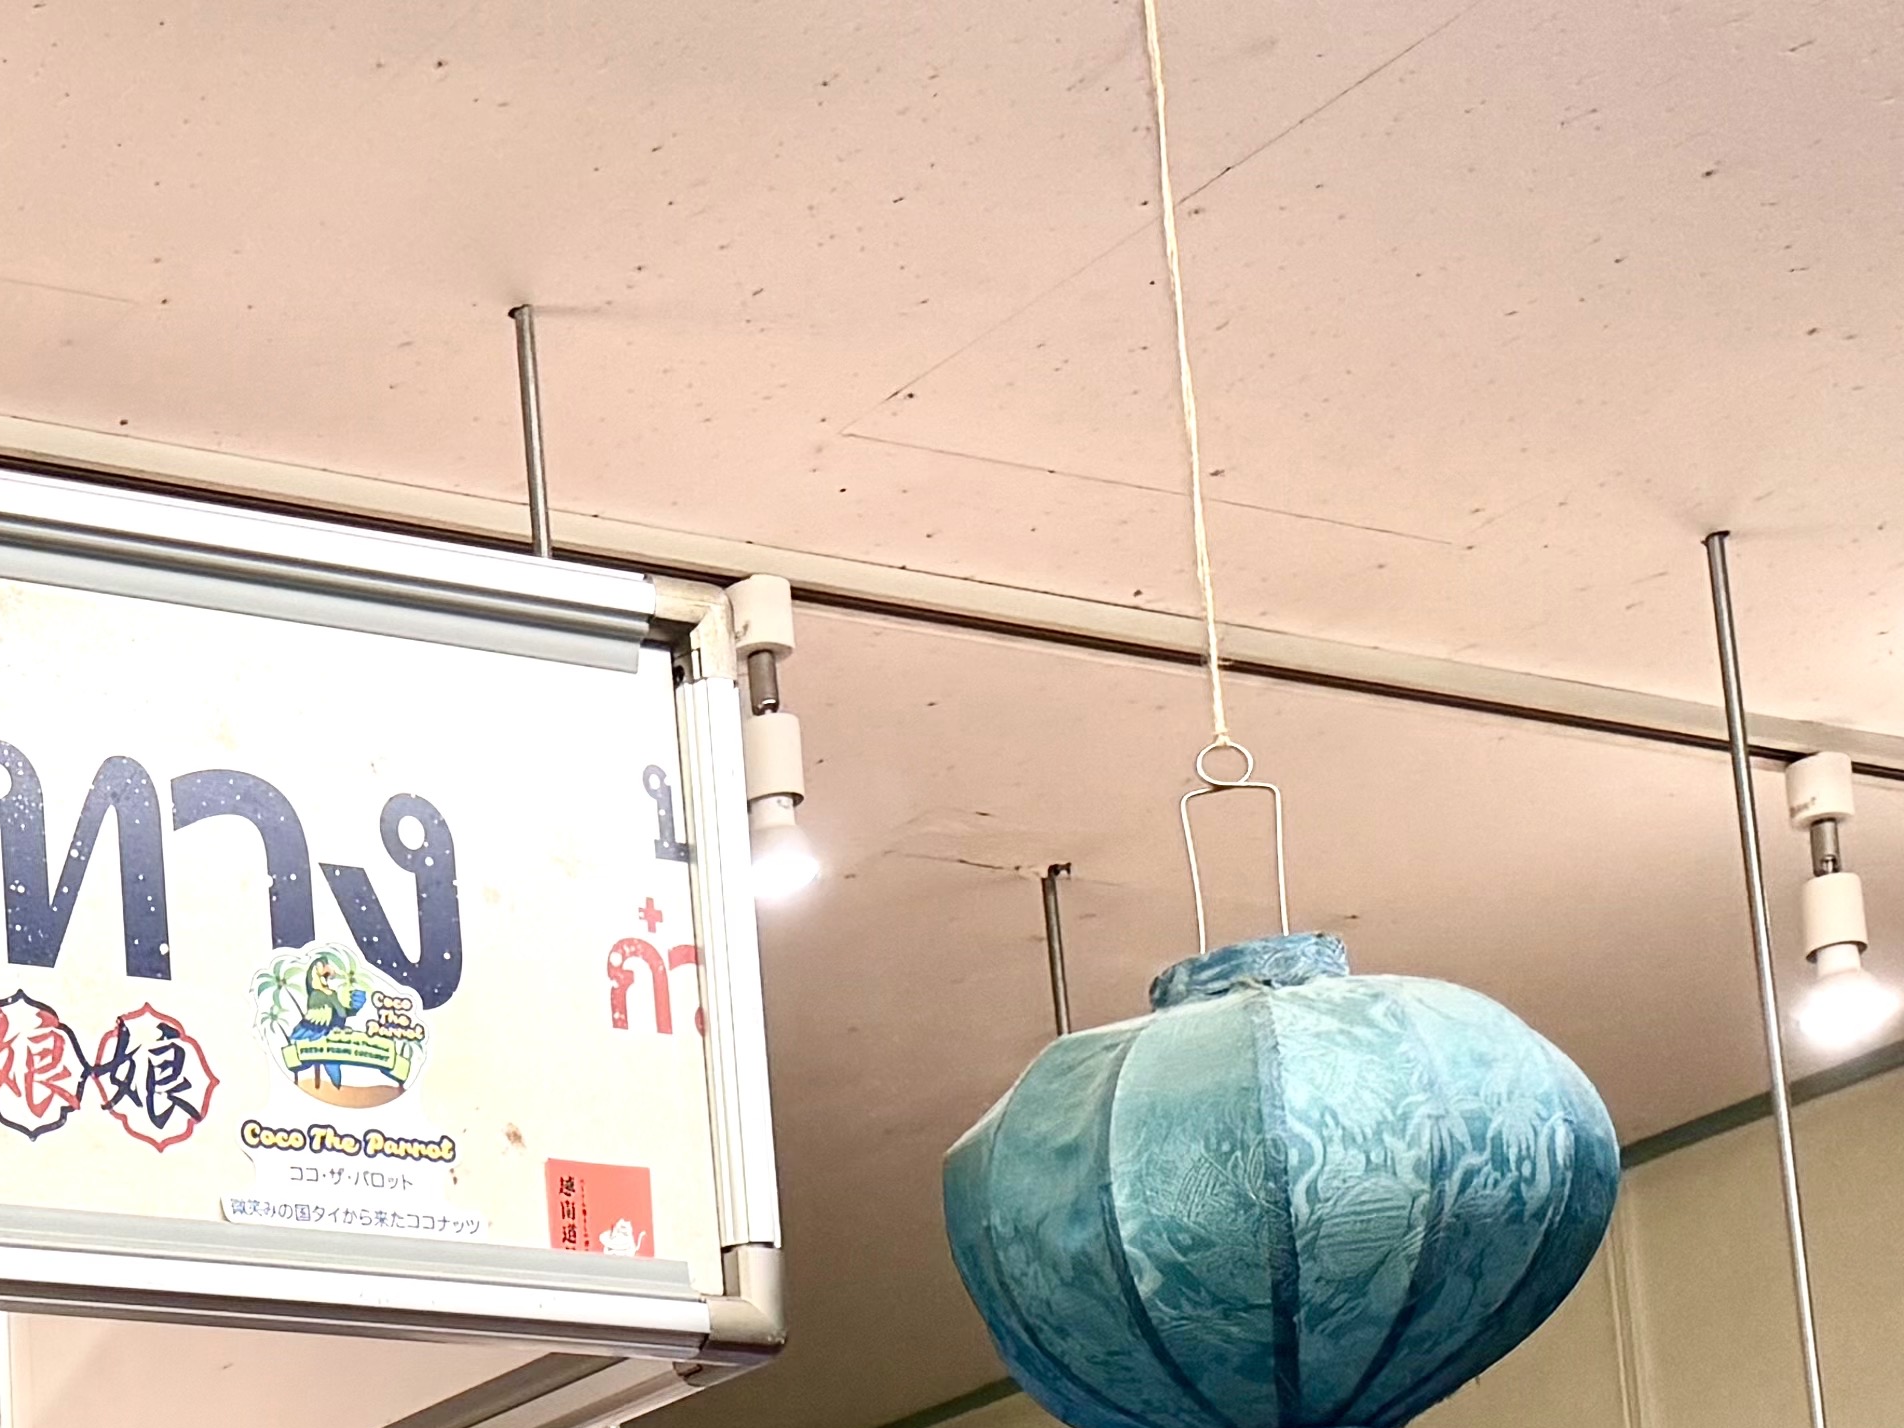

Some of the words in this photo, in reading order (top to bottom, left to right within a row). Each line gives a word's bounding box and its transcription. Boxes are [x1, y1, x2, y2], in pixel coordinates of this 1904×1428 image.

[93, 1016, 201, 1129] 娘
[241, 1120, 306, 1149] Coco
[308, 1124, 362, 1156] The
[363, 1129, 456, 1162] Parrot
